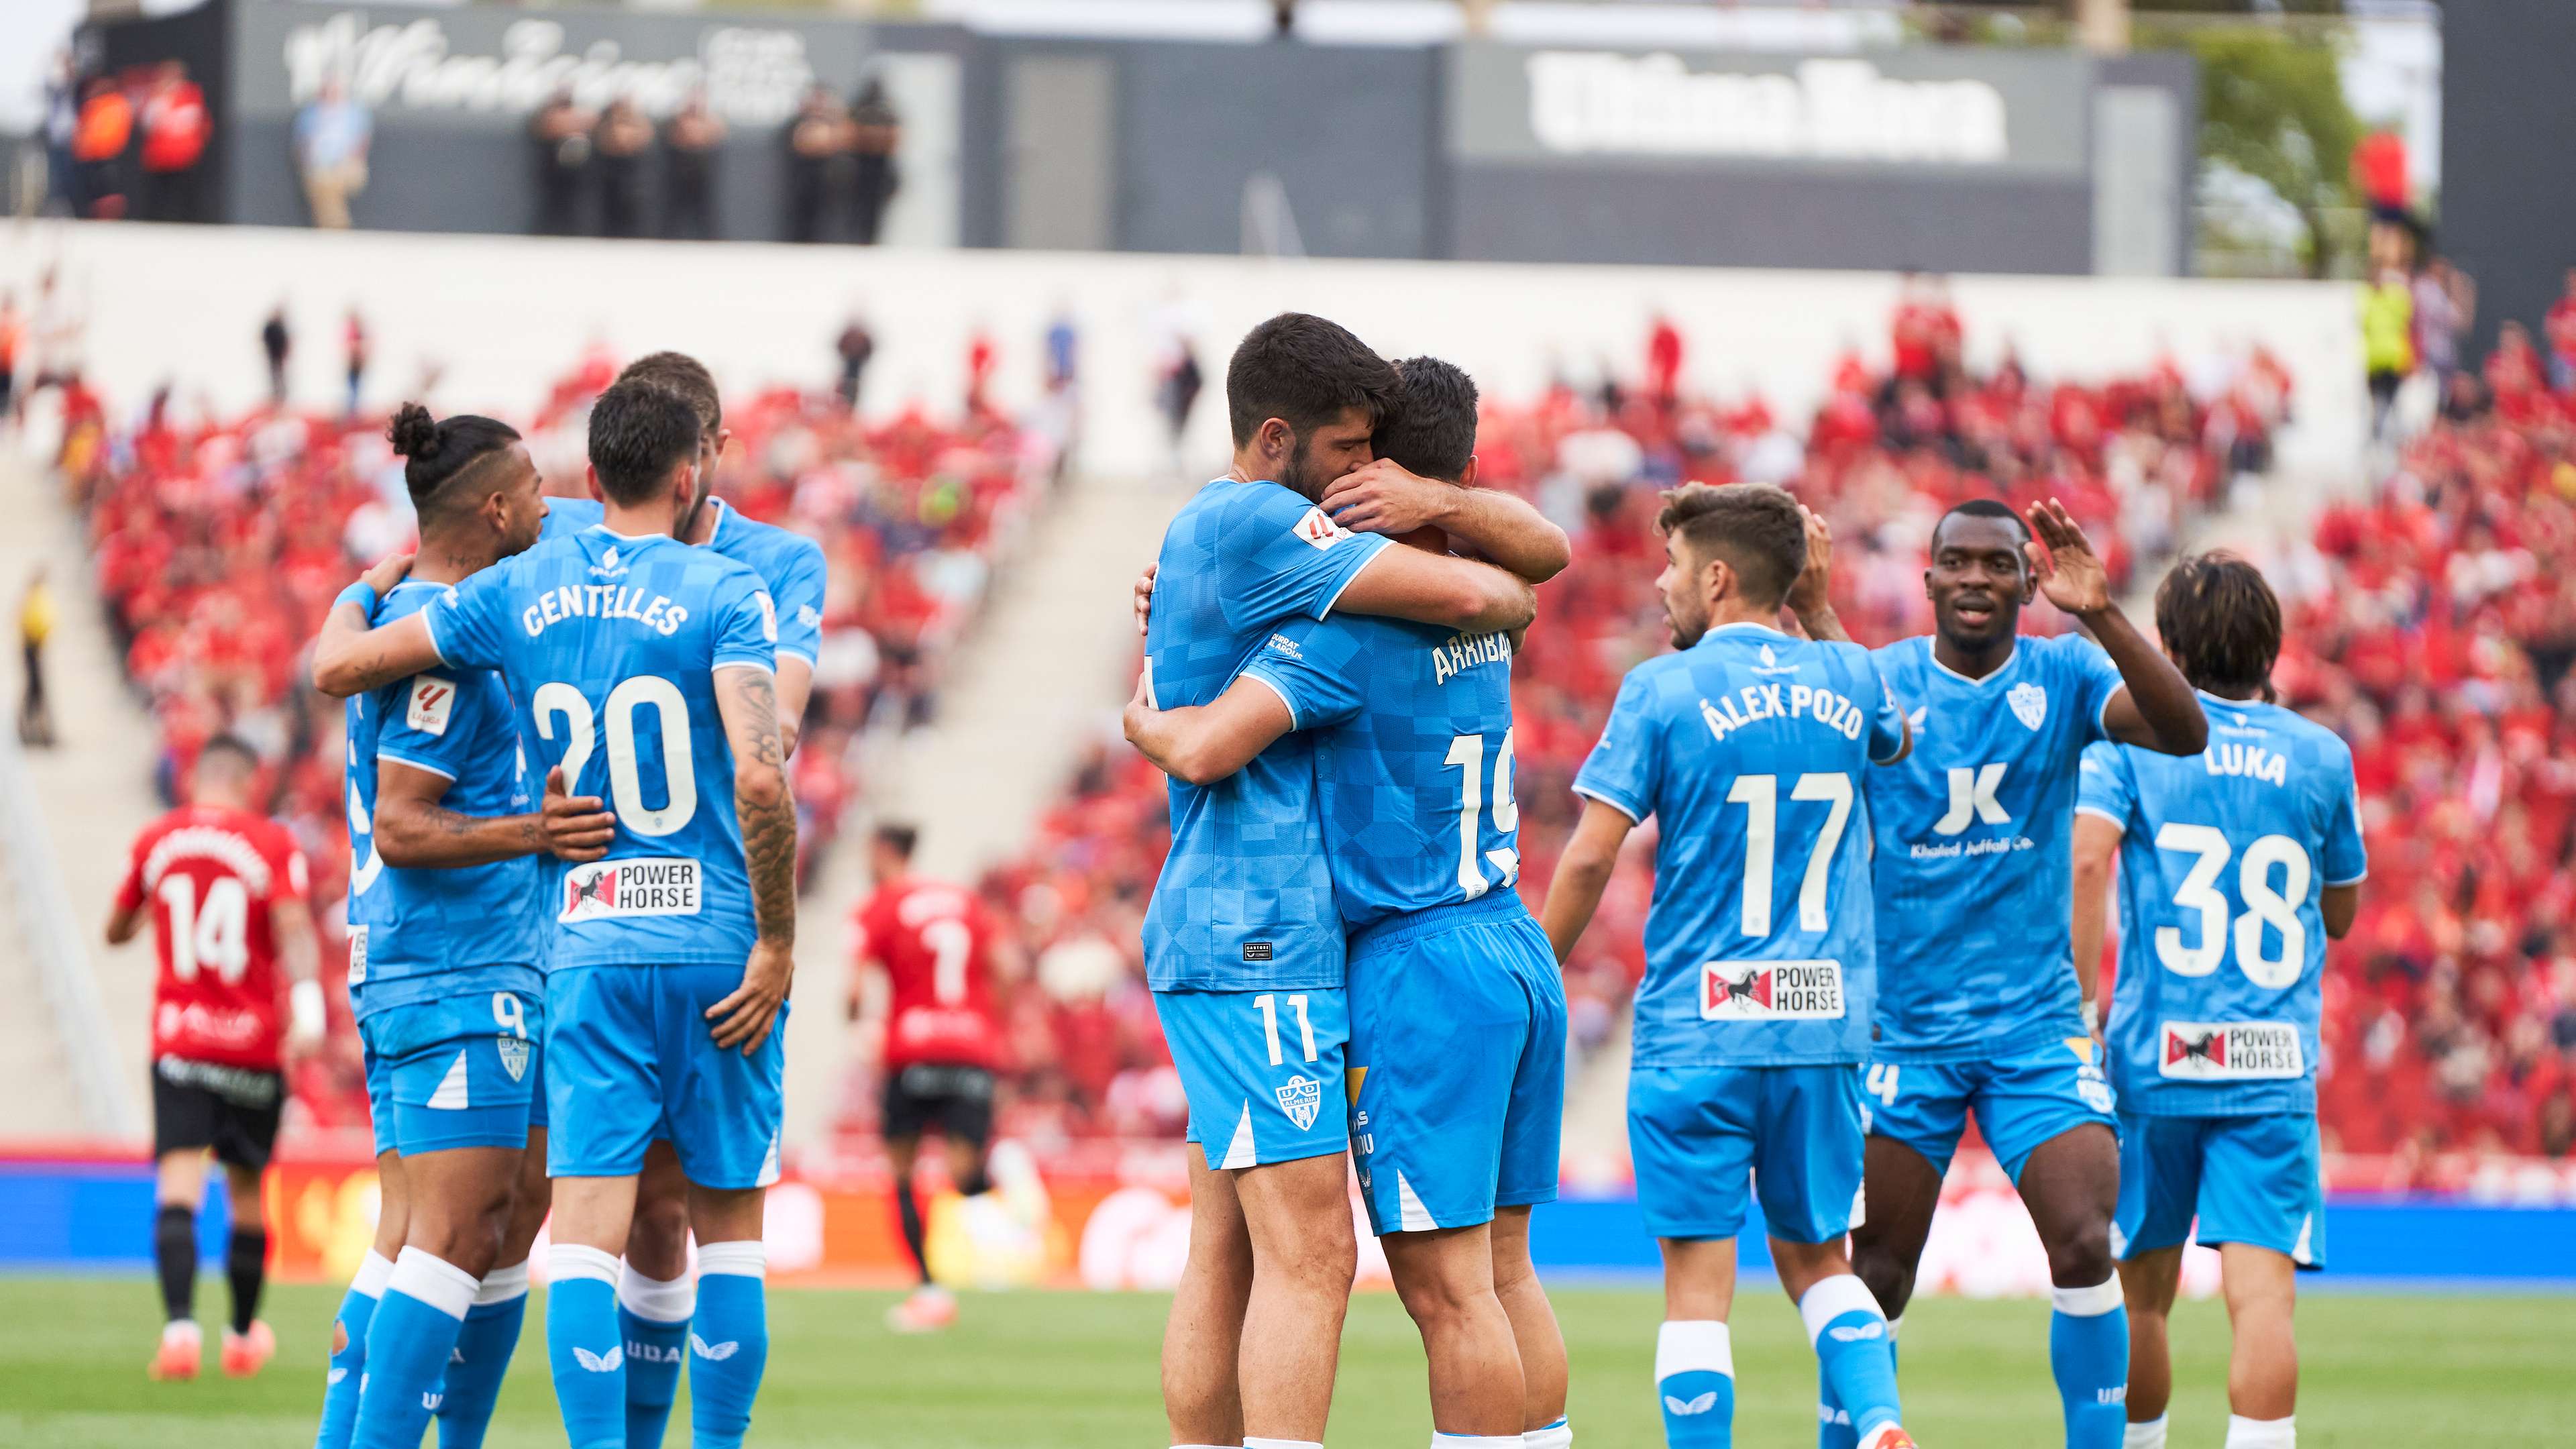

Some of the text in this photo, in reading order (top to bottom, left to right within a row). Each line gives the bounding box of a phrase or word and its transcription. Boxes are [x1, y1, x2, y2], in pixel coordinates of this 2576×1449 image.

[523, 584, 688, 637] CENTELLES
[1699, 683, 1864, 741] ÁLEX POZO
[533, 675, 698, 837] 20
[2203, 743, 2287, 787] LUKA
[1934, 762, 2011, 835] JK
[1726, 772, 1854, 938] 17
[1911, 841, 1961, 859] Khaled
[621, 865, 694, 887] POWER
[620, 888, 694, 909] HORSE
[2154, 822, 2312, 989] 38
[158, 873, 250, 983] 14
[1776, 967, 1835, 988] POWER
[1776, 991, 1839, 1011] HORSE
[1252, 993, 1318, 1067] 11
[2231, 1029, 2292, 1047] POWER
[2231, 1051, 2296, 1069] HORSE
[1285, 1096, 1317, 1107] ALMERIA
[627, 1340, 681, 1363] UDA
